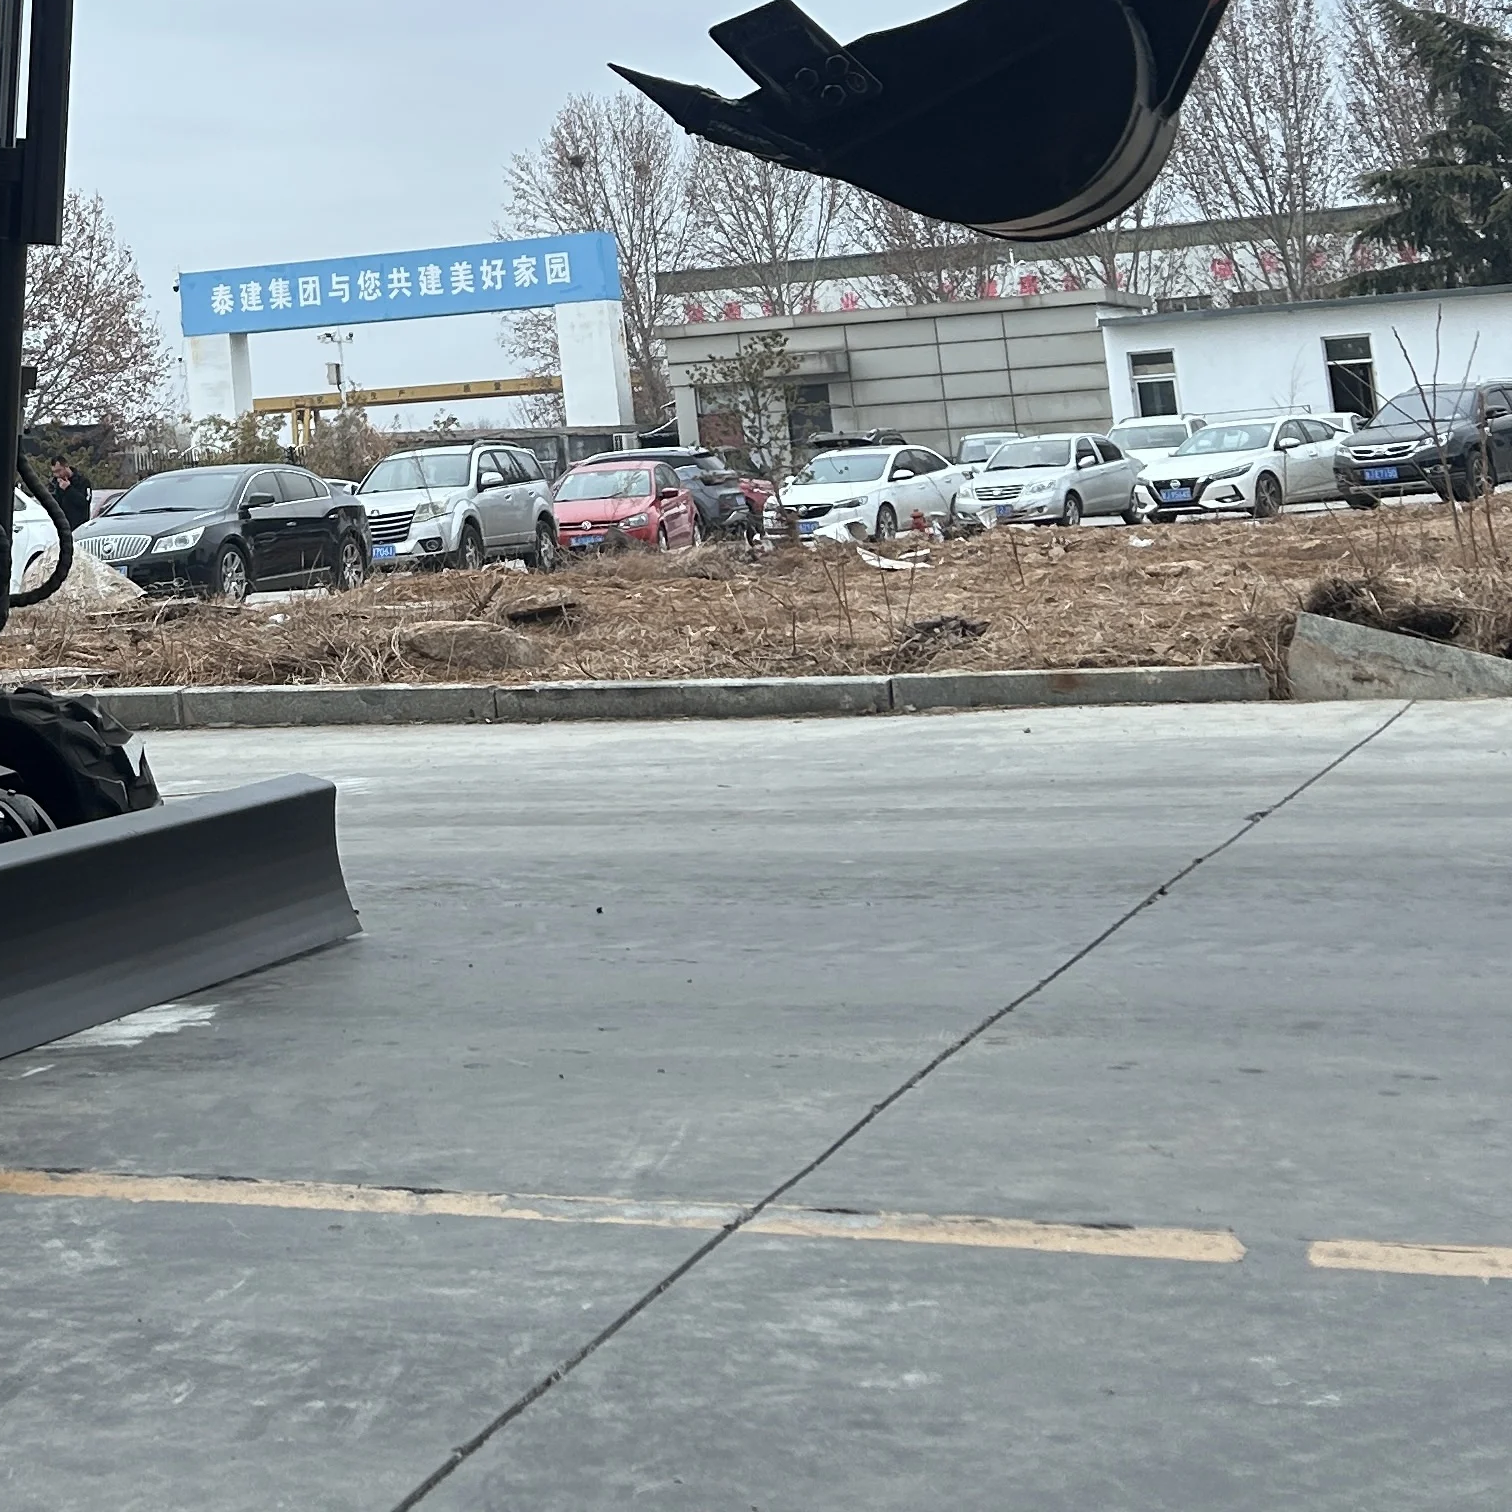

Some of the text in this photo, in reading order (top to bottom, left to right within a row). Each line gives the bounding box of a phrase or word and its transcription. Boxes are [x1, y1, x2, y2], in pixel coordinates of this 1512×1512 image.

[210, 251, 572, 316] 泰建集团与您共建美好家园
